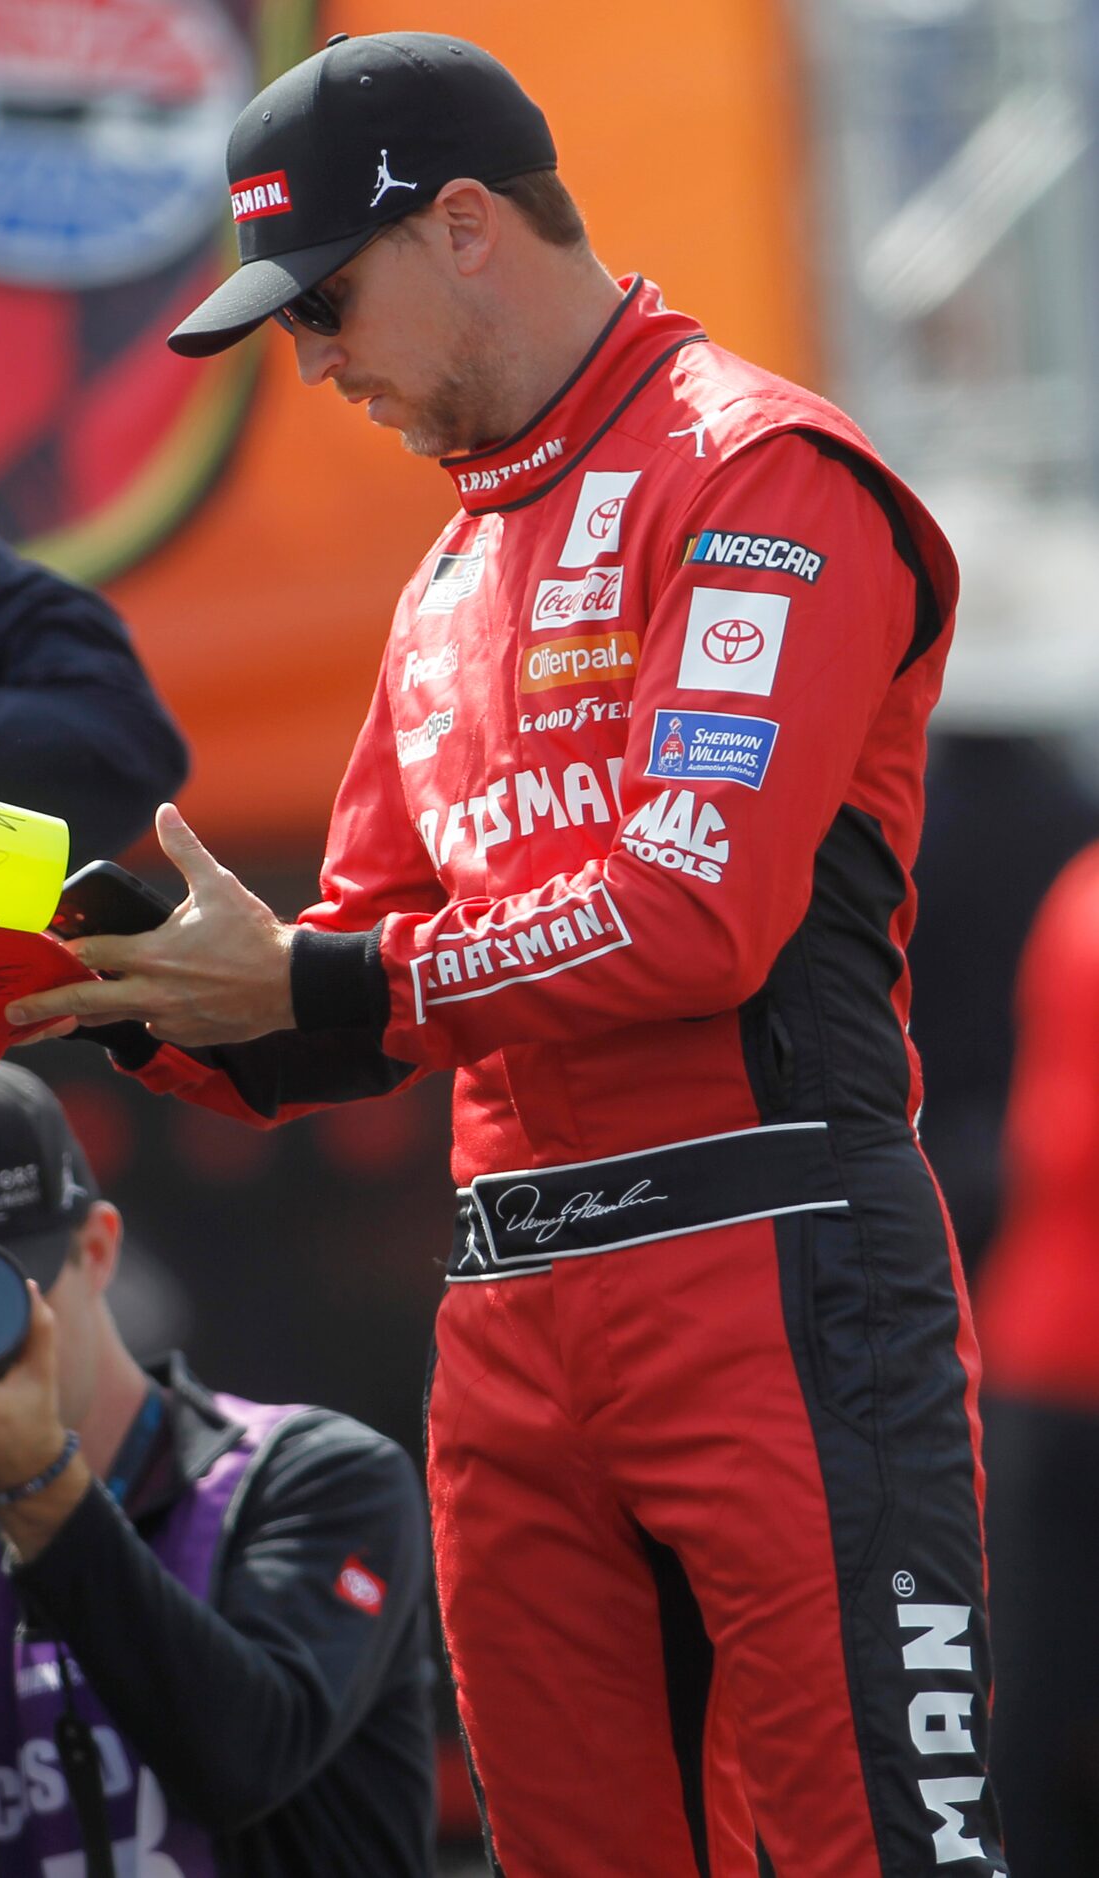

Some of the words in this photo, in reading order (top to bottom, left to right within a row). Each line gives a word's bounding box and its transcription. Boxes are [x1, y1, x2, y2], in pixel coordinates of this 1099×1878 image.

[705, 533, 821, 581] NASCAR
[528, 638, 618, 681] Offerpad
[692, 728, 763, 750] SHERWIN
[687, 763, 727, 772] Automotive
[727, 764, 756, 778] Finishes
[415, 757, 624, 872] AFTSMA
[622, 790, 729, 864] MAC
[621, 837, 723, 883] TOOLS
[427, 903, 605, 989] AFTSMAN
[897, 1604, 1007, 1878] MAN
